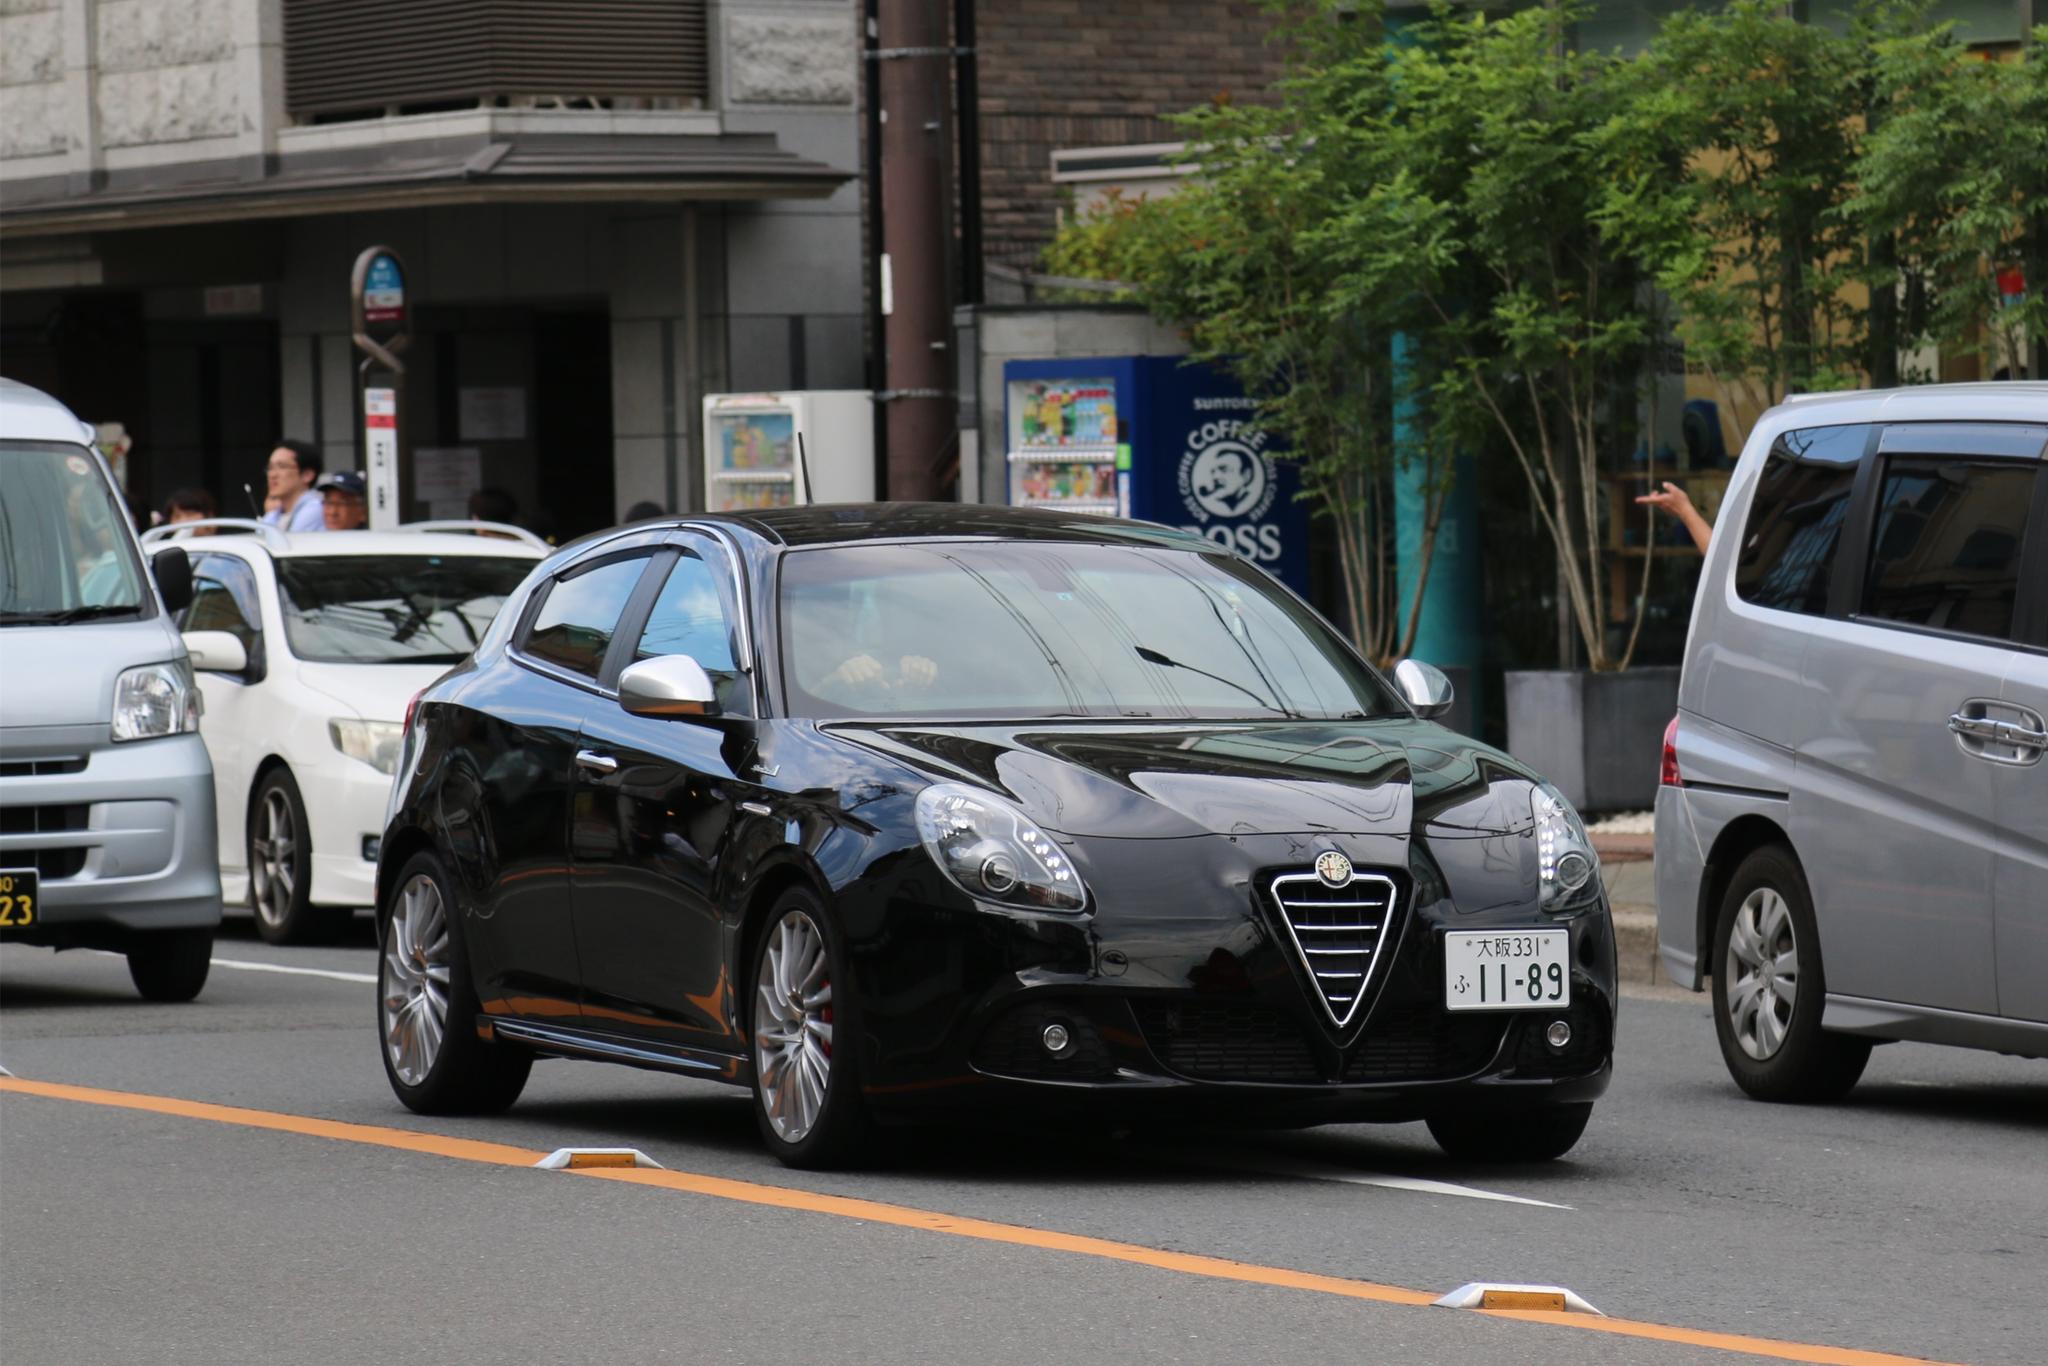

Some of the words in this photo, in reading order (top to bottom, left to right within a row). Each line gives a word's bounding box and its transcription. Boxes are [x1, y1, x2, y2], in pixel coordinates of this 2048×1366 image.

[0, 895, 33, 925] 23
[1454, 975, 1470, 993] ふ
[1480, 963, 1563, 1002] 11-89
